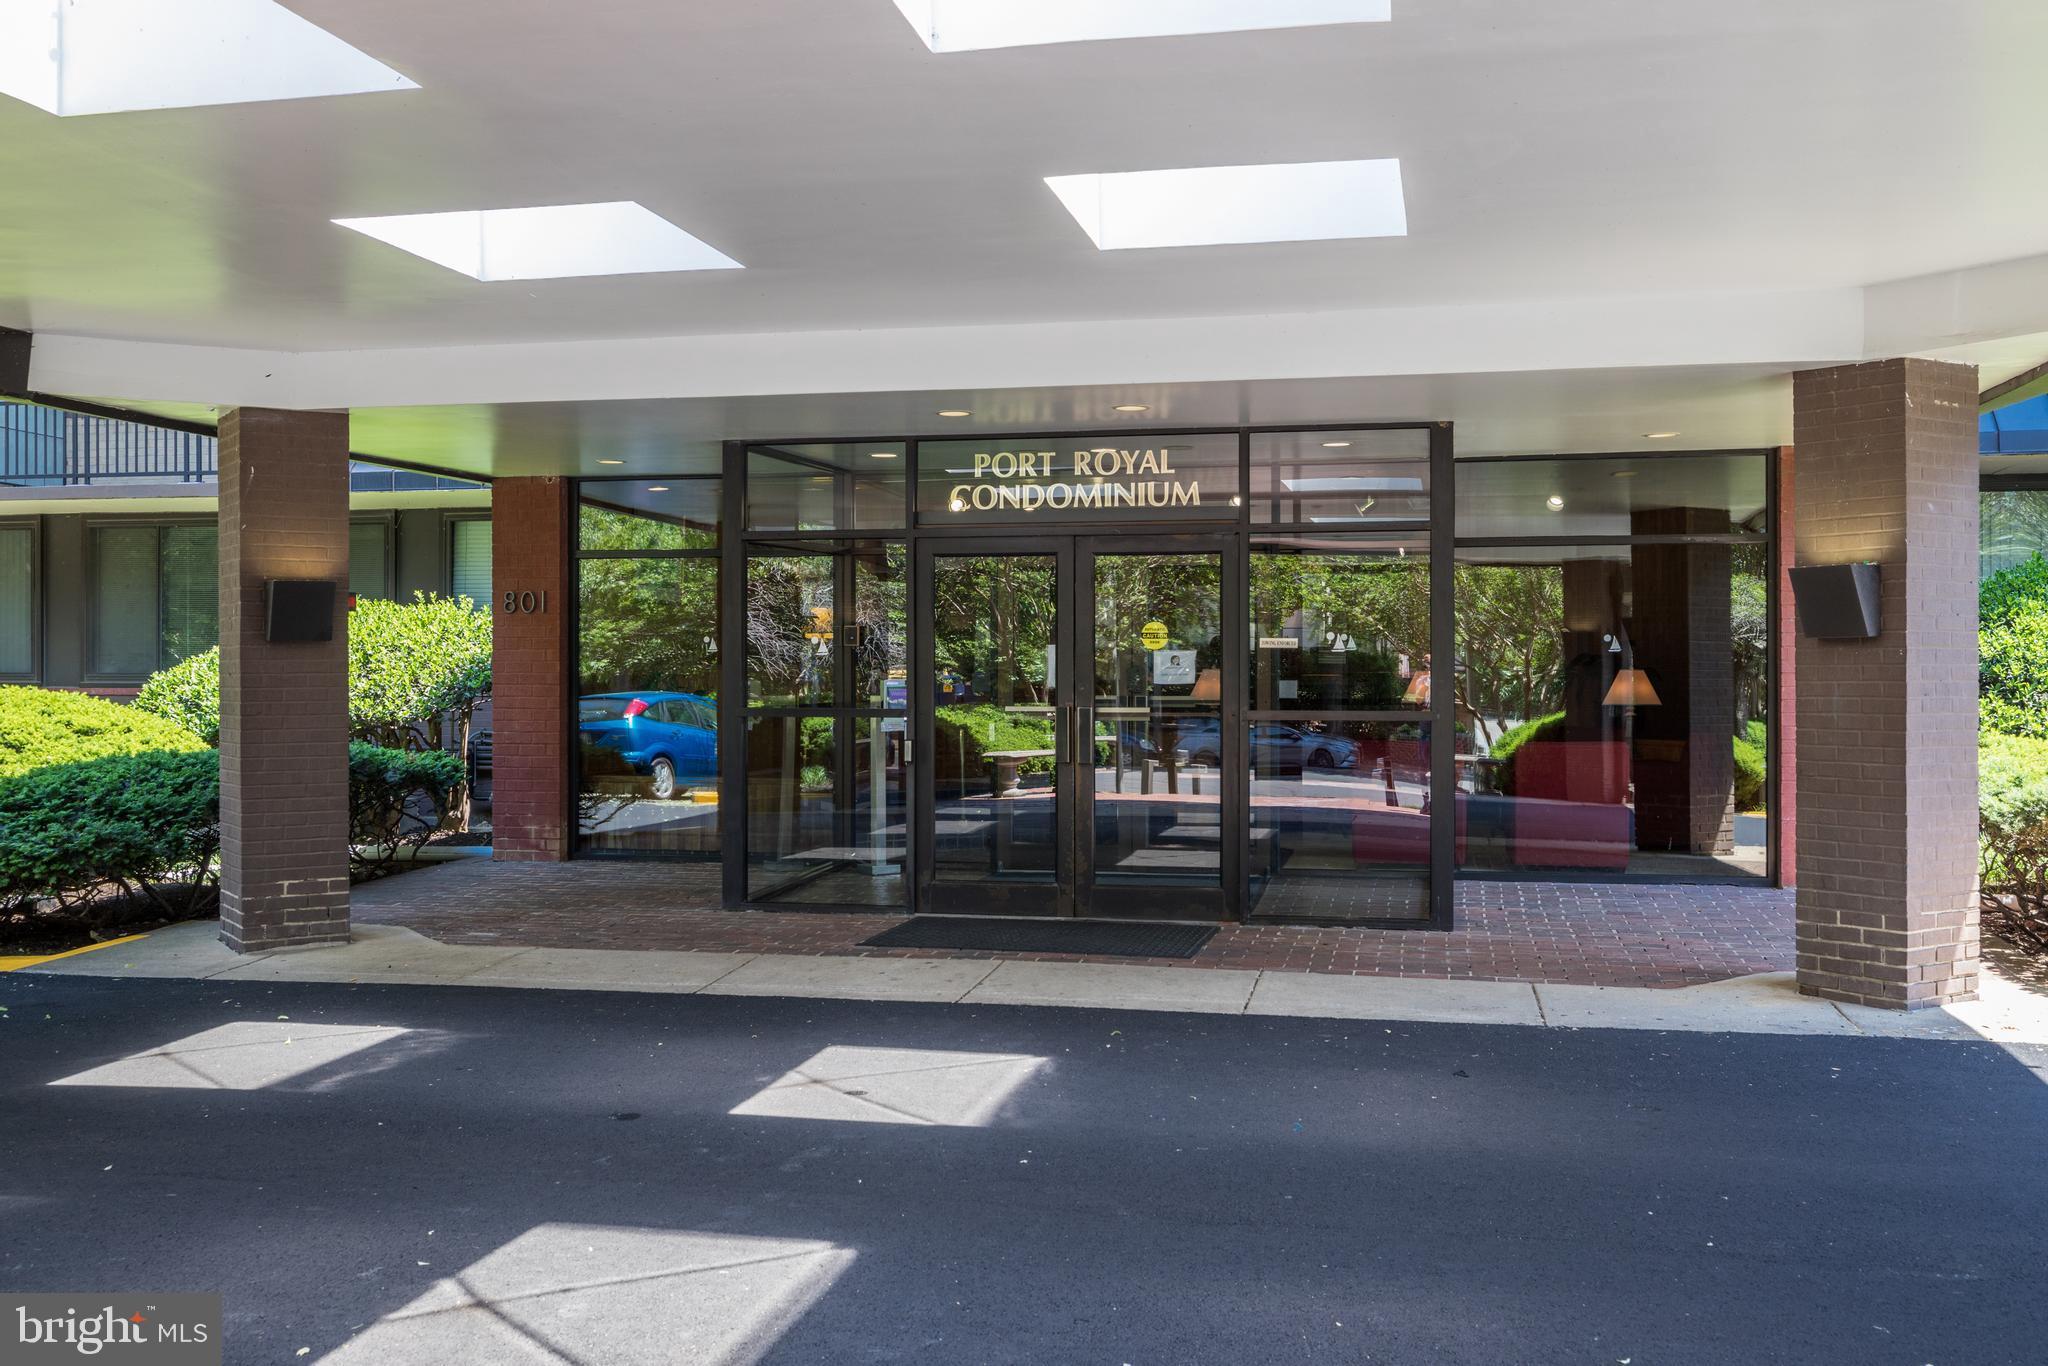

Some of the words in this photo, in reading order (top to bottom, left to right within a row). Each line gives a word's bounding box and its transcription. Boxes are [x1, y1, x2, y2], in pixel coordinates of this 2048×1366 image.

[974, 452, 1056, 478] PORT
[1074, 449, 1175, 476] ROYAL
[950, 481, 1200, 510] CONDOMINIUM
[503, 590, 545, 614] 801
